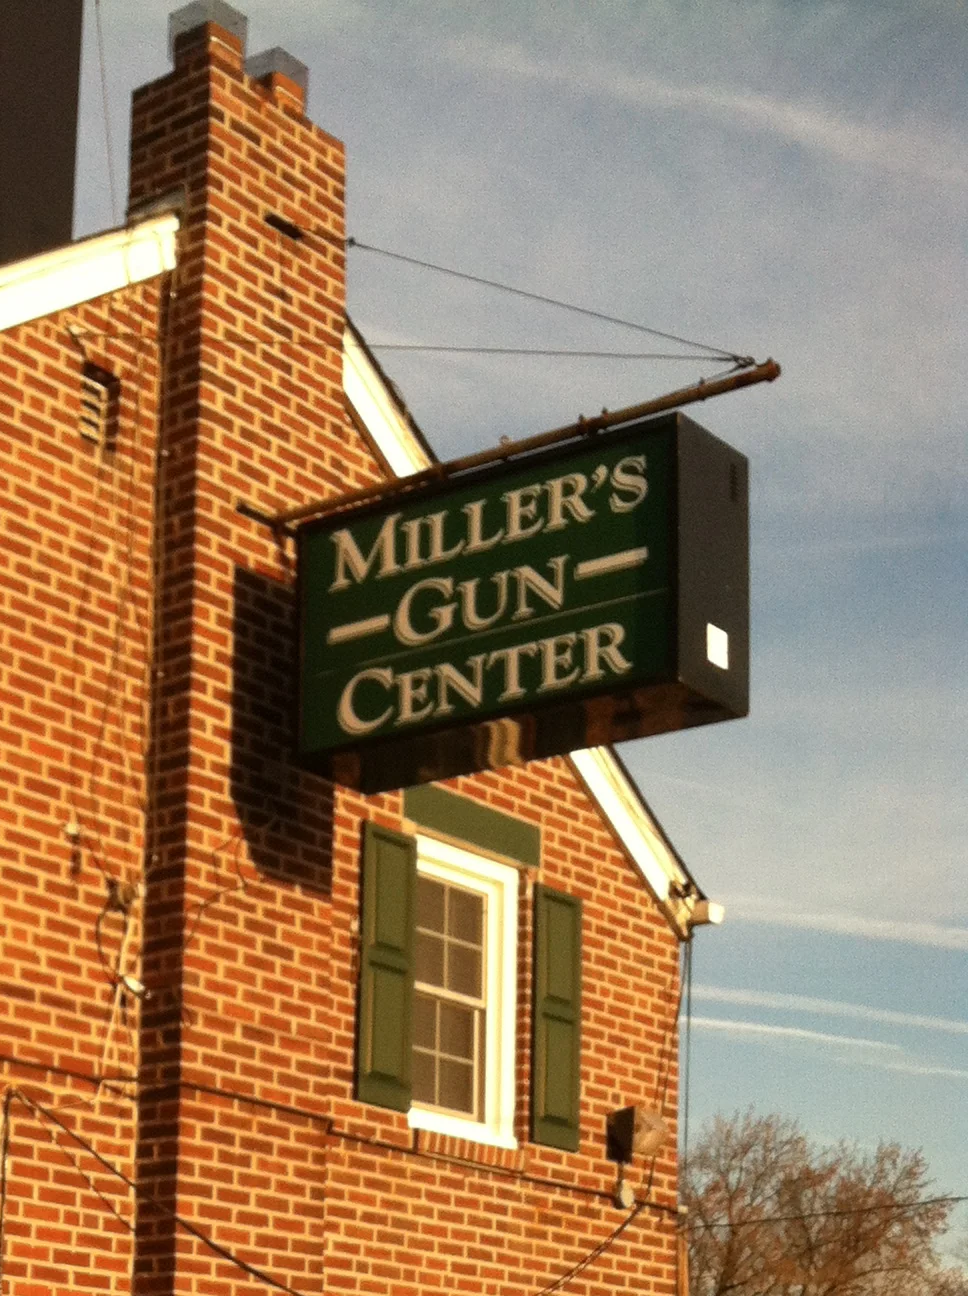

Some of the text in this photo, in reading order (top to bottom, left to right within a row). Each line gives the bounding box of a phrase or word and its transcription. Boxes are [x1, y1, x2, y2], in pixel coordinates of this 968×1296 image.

[329, 455, 649, 592] MILLER'S
[393, 555, 569, 647] GUN
[337, 623, 633, 736] CENTER
